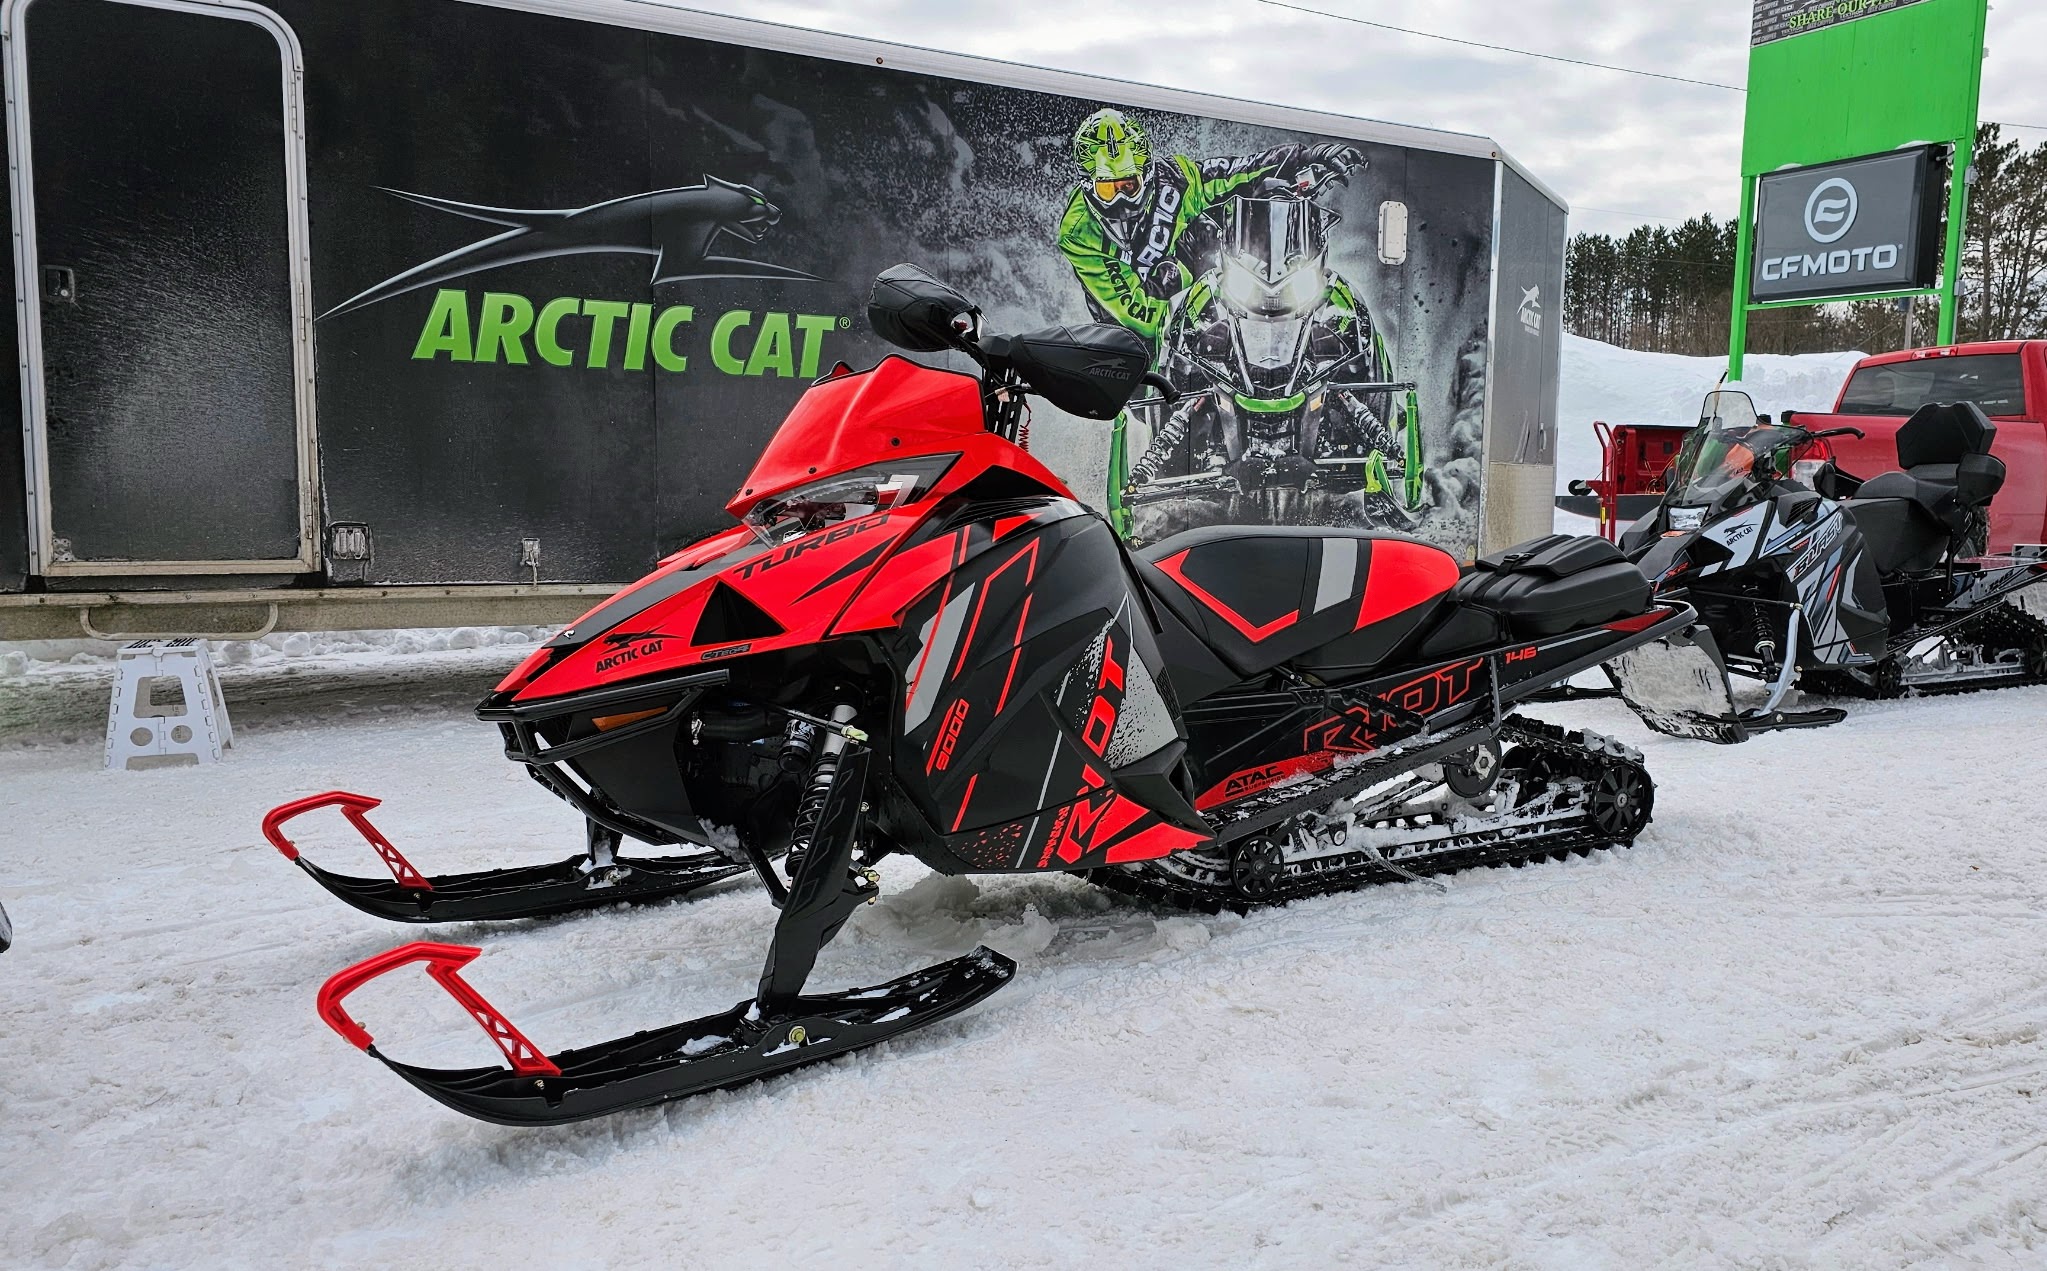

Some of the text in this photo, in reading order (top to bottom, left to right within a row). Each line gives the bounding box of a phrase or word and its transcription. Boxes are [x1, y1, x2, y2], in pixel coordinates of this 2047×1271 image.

[1789, 0, 1867, 28] SHARE OUR
[1761, 244, 1898, 281] CFMOTO
[1128, 302, 1157, 323] CAT
[411, 288, 837, 378] ARCTIC CAT
[1088, 367, 1131, 381] ARCTIC CAT
[733, 513, 890, 581] TURBO
[1726, 526, 1754, 547] ARCTIC CAT
[596, 640, 663, 673] ARCTIC CAT
[1505, 646, 1538, 664] 146
[935, 698, 970, 771] 9000
[1225, 766, 1283, 793] ATAC
